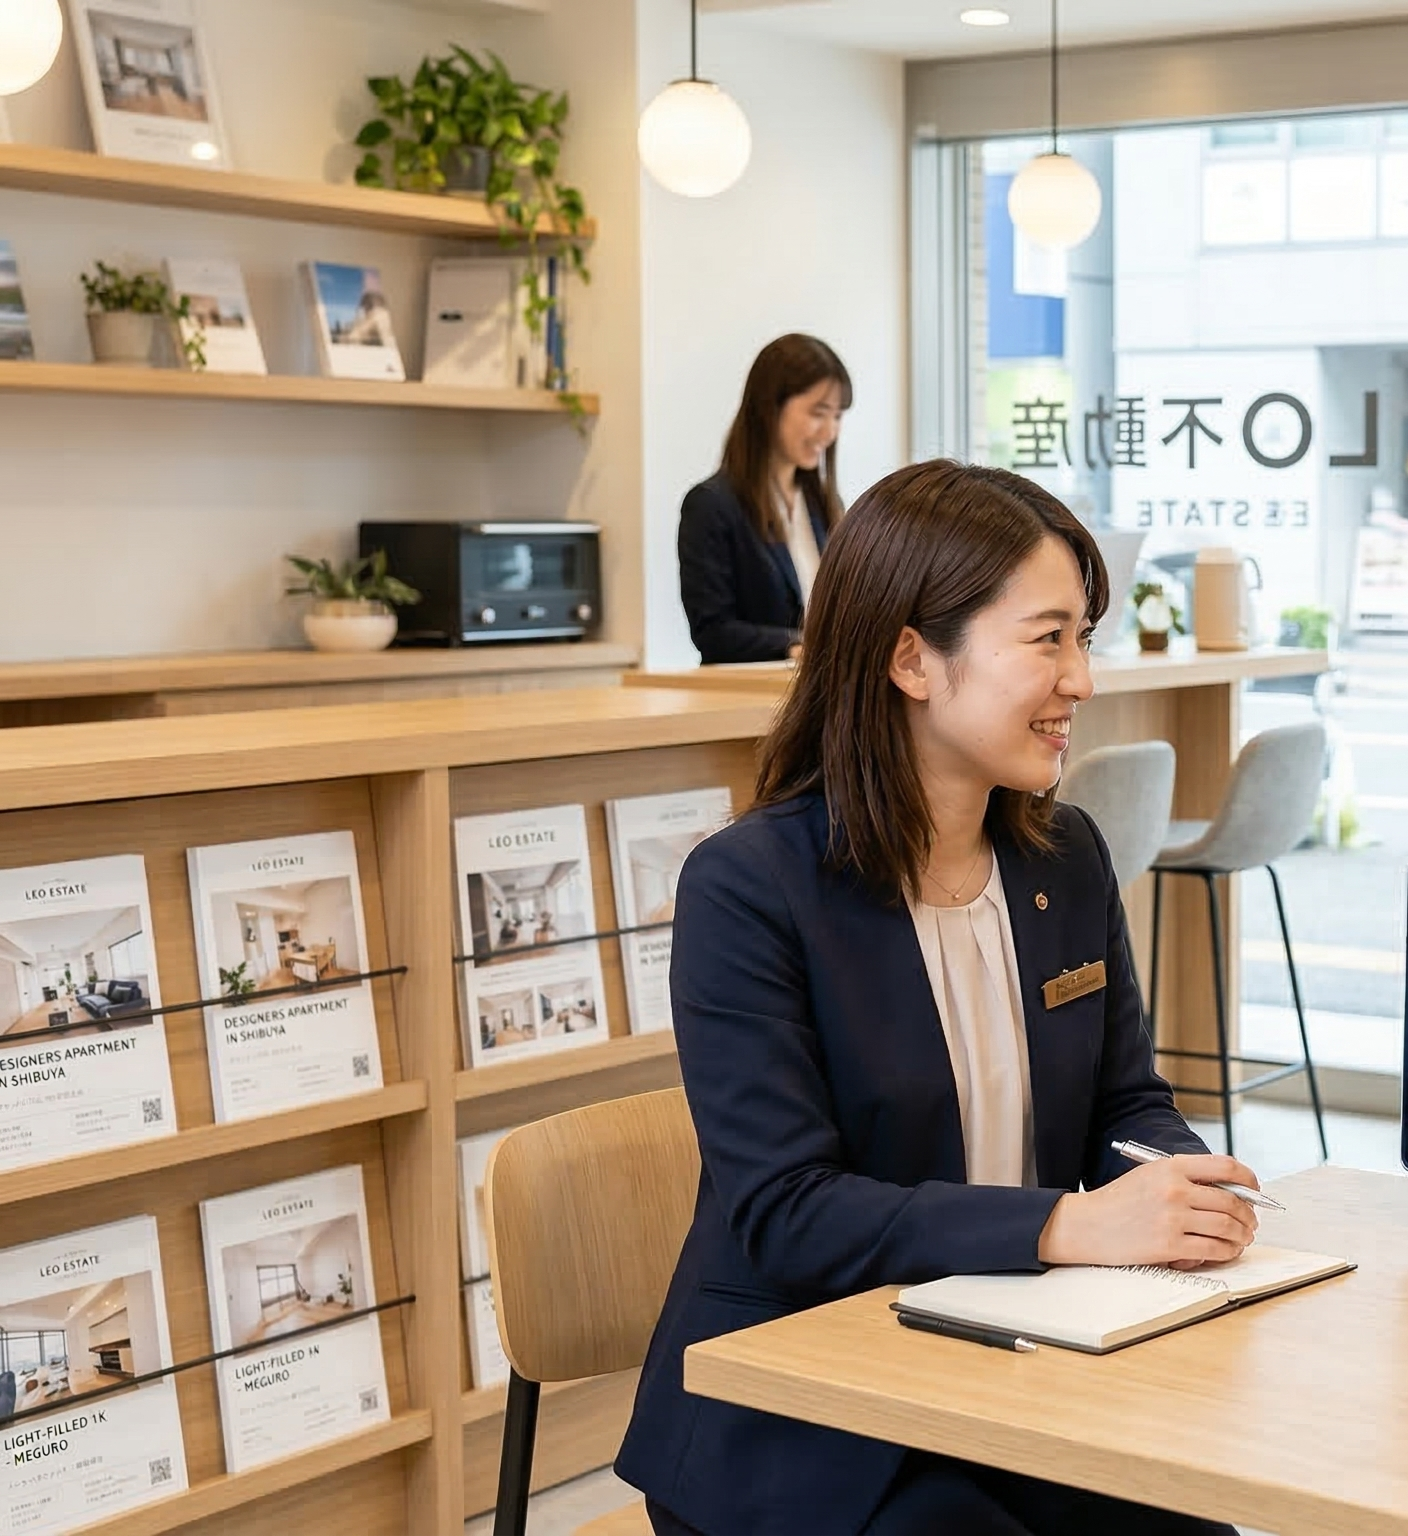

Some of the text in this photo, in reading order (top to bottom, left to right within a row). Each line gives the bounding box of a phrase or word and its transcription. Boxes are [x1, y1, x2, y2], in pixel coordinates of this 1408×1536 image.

[488, 831, 556, 848] LEO ESTATE
[49, 884, 87, 897] ESTATE
[224, 997, 348, 1029] DESIGNERS APARTMENT
[226, 1025, 286, 1045] IN SHIBUYA
[0, 1038, 137, 1071] ESIGNERS APARTMENT
[11, 1067, 66, 1087] SHIBUYA
[40, 1255, 100, 1277] LEO ESTATE
[235, 1349, 305, 1379] LIGHT-FILLED
[244, 1369, 290, 1392] MEGURO
[4, 1409, 108, 1451] LIGHT-FILLED 1K
[14, 1439, 69, 1466] MEGURO
